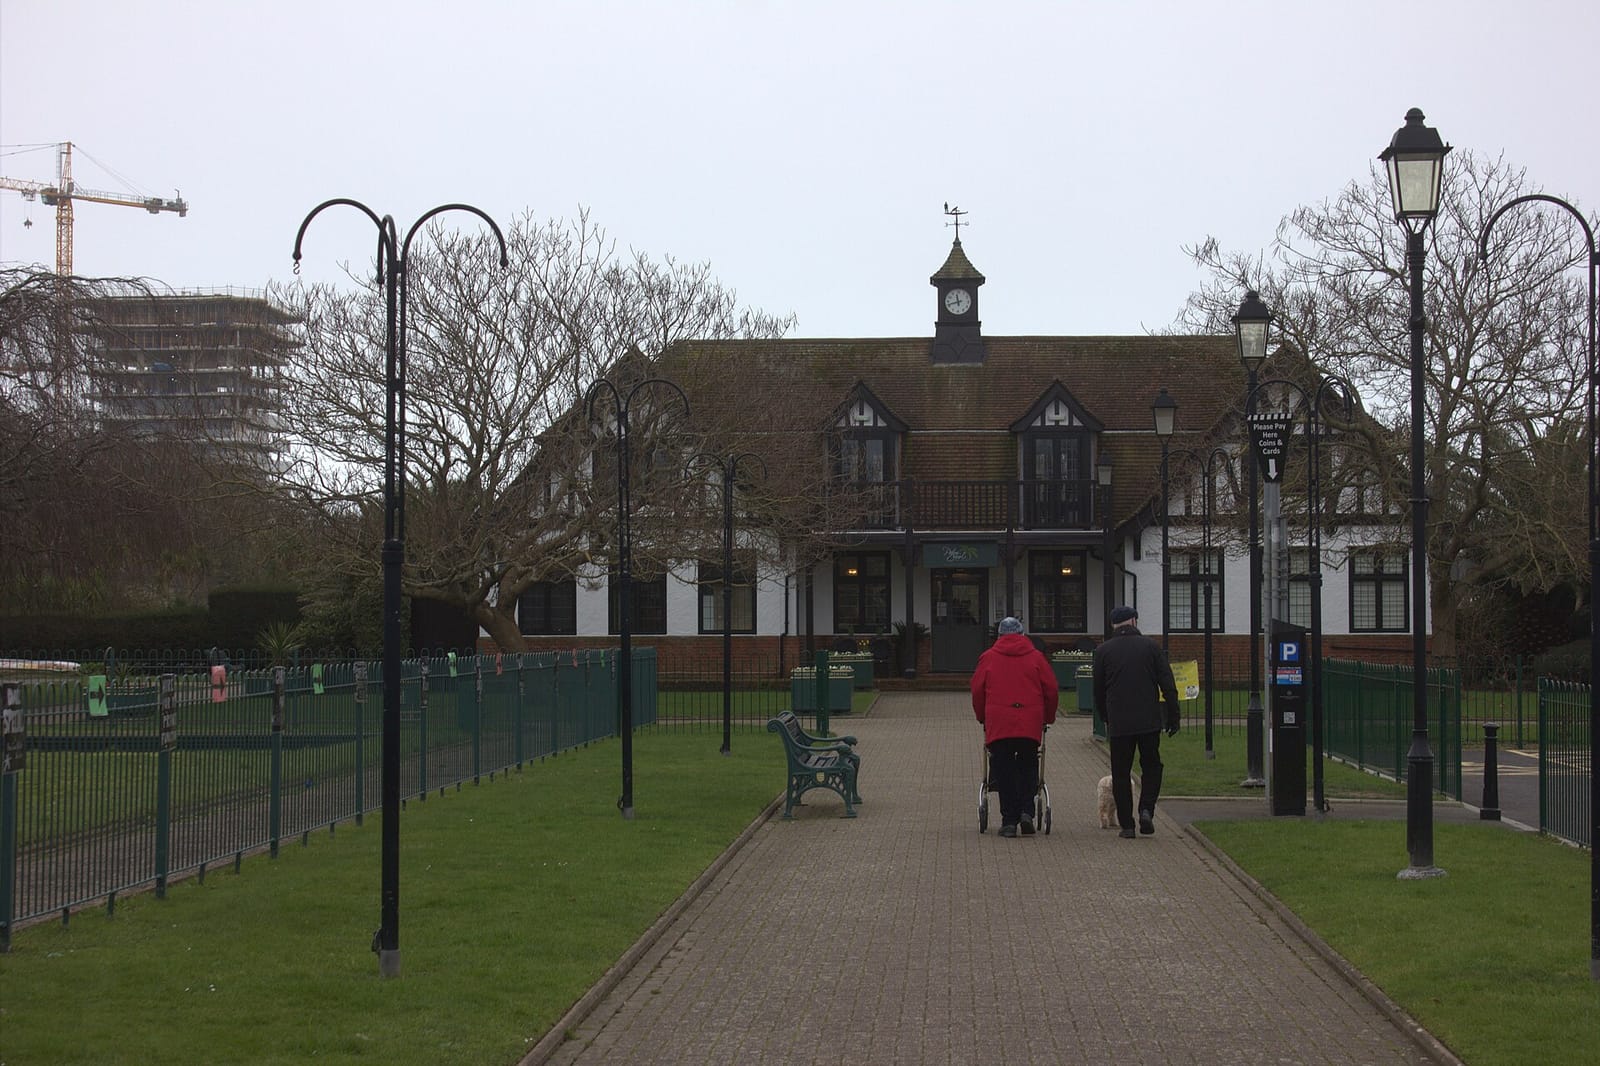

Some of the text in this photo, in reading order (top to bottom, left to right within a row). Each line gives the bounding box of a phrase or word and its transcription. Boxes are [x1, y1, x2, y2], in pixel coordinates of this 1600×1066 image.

[1253, 422, 1286, 431] Please Pay
[1283, 643, 1297, 661] P
